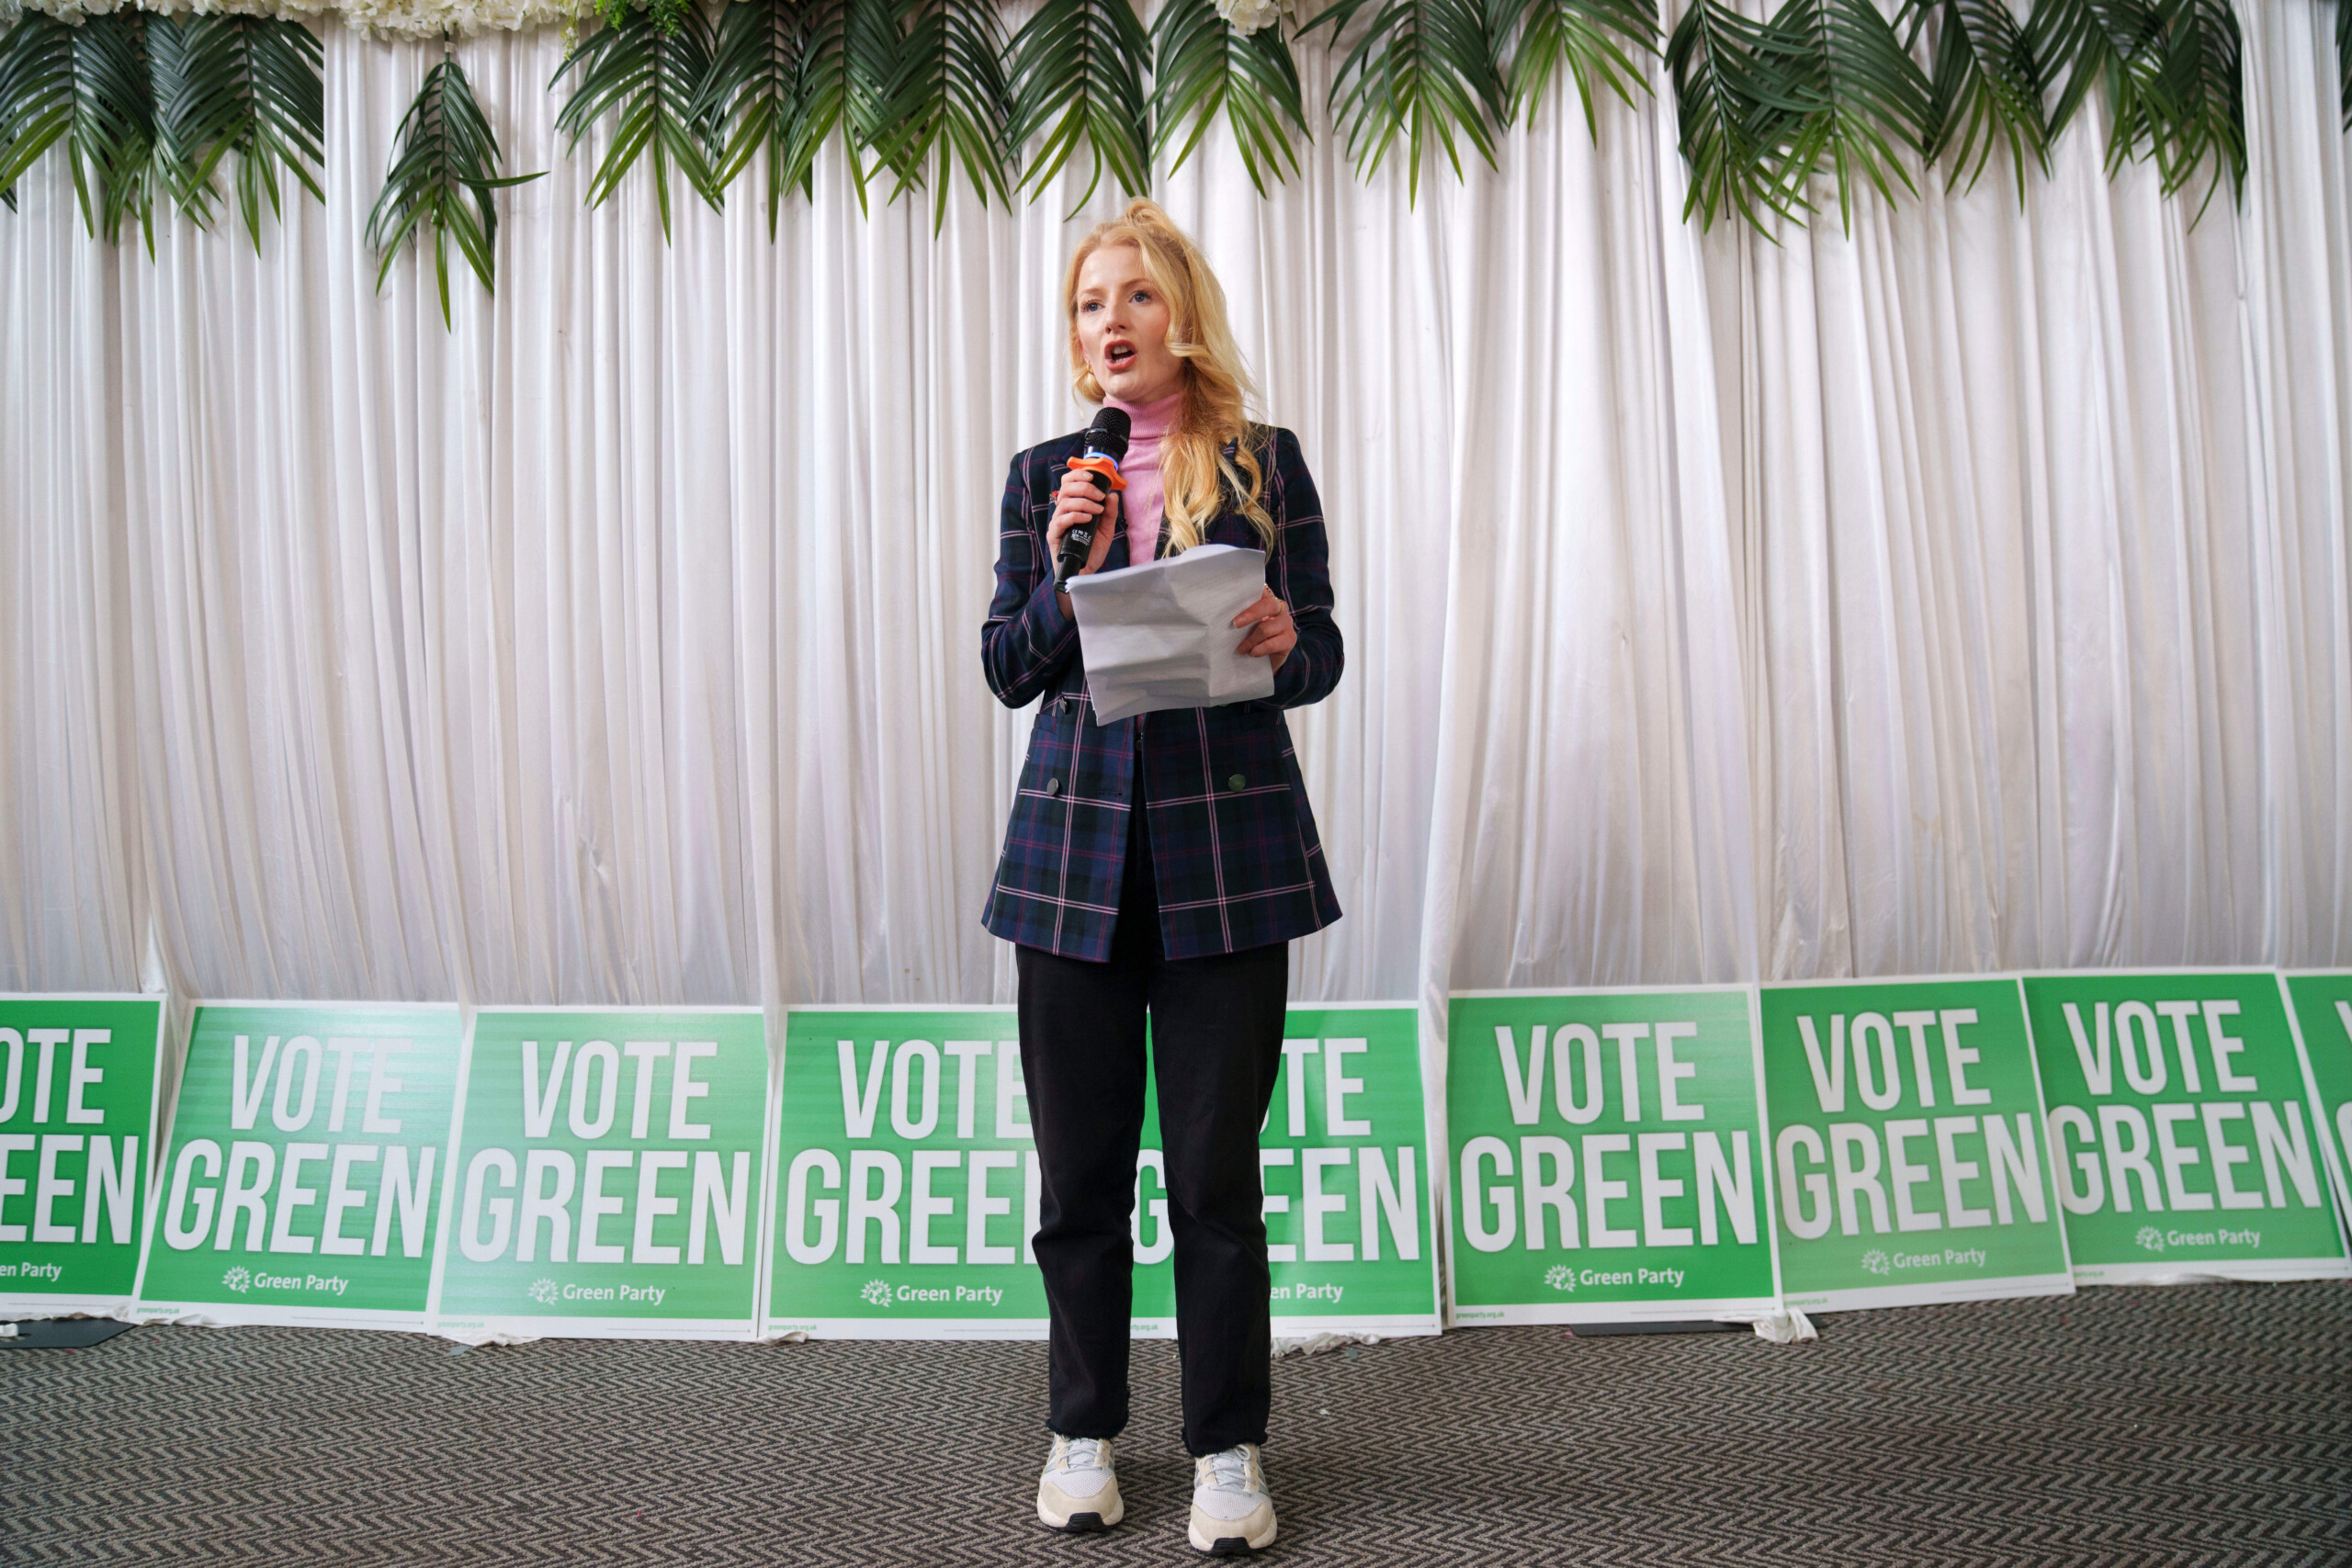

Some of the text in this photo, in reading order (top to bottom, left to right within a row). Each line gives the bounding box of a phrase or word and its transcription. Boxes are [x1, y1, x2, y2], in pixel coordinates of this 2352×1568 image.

[0, 1027, 111, 1123] OTE
[231, 1034, 414, 1134] VOTE
[522, 1040, 718, 1140] VOTE
[837, 1039, 1034, 1140] VOTE
[1495, 1021, 1705, 1125] VOTE
[1797, 1009, 1992, 1113] VOTE
[2062, 999, 2258, 1096] VOTE
[0, 1134, 139, 1245] EEN
[164, 1138, 436, 1258] GREEN
[459, 1147, 751, 1265] GREEN
[1460, 1131, 1758, 1253] GREEN
[1775, 1112, 2048, 1240] GREEN
[2047, 1100, 2323, 1215] GREEN
[21, 1261, 62, 1282] Party
[254, 1272, 349, 1296] Green Party
[1579, 1267, 1685, 1288] Green Party
[1893, 1248, 1986, 1269] Green Party
[2167, 1228, 2261, 1247] Green Party
[562, 1284, 666, 1306] Green Party
[897, 1285, 1003, 1307] Green Party
[1296, 1283, 1343, 1303] Party
